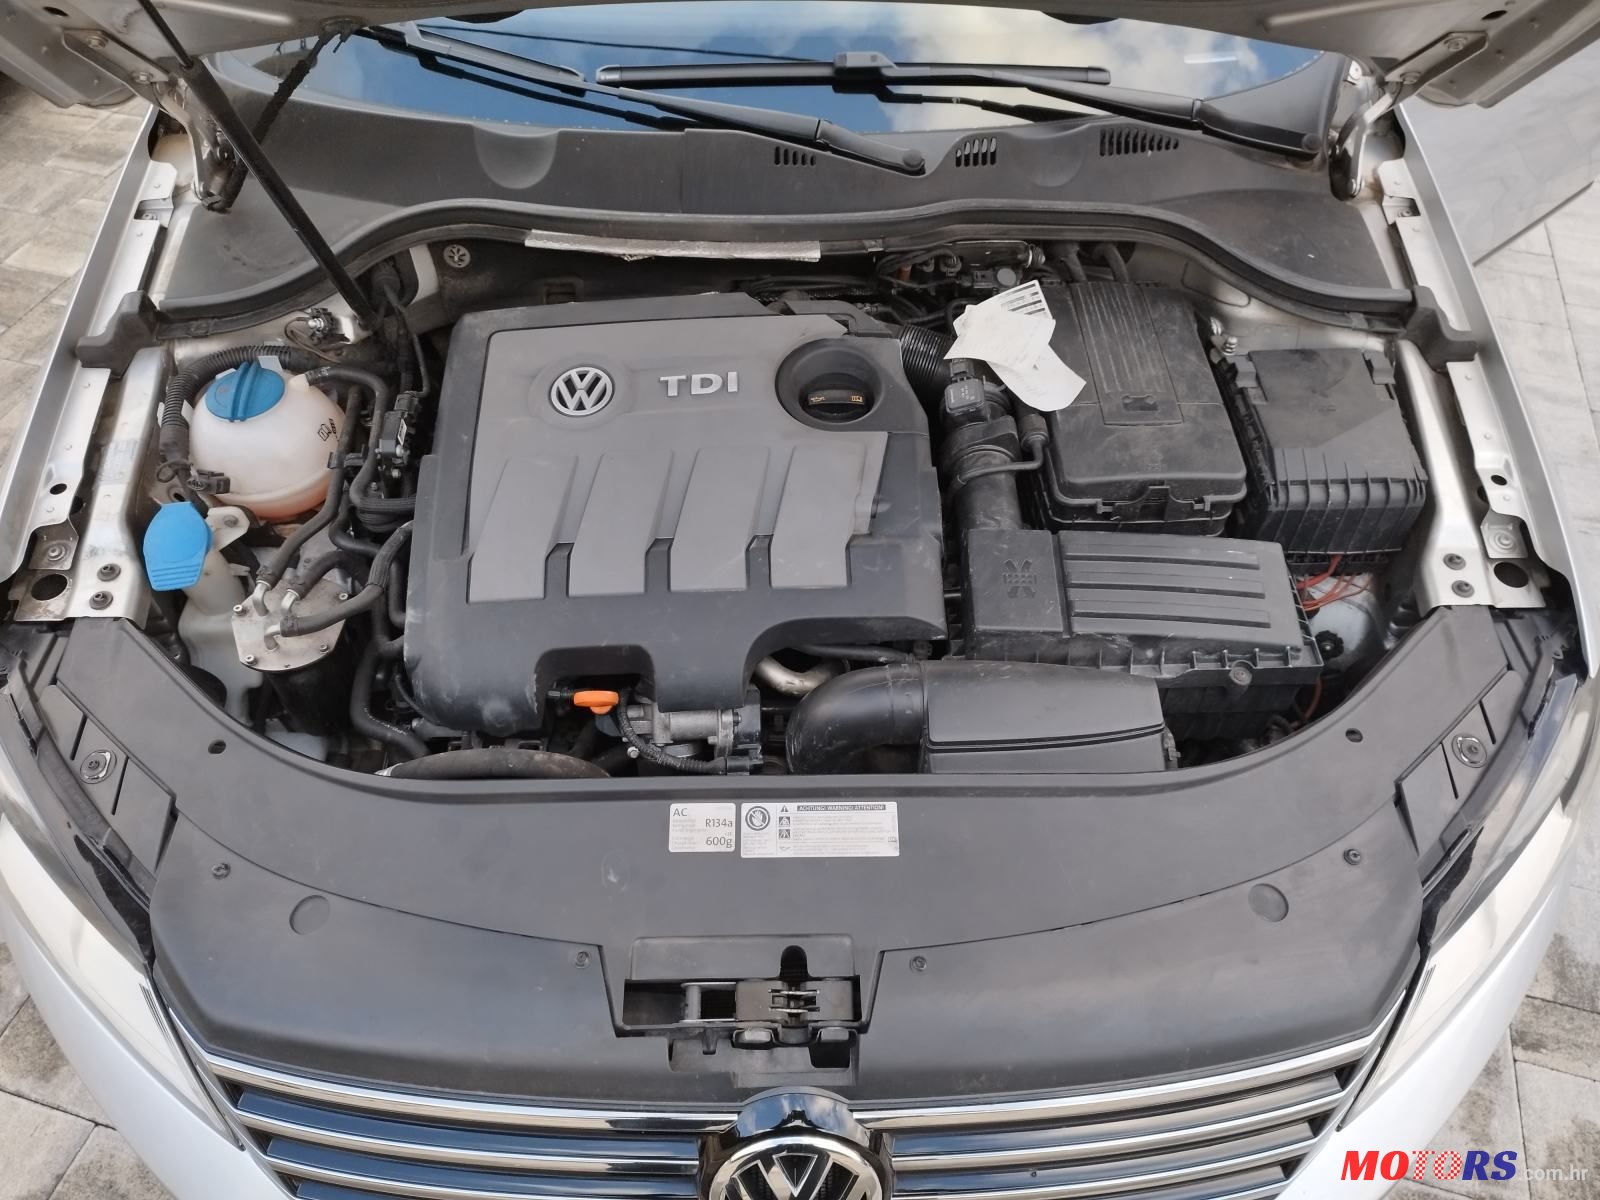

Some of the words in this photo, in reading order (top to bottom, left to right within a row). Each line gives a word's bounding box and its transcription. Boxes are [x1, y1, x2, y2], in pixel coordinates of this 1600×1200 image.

[660, 371, 738, 397] TDI
[672, 807, 688, 817] AC
[705, 818, 733, 828] R134a
[705, 836, 733, 849] 600g
